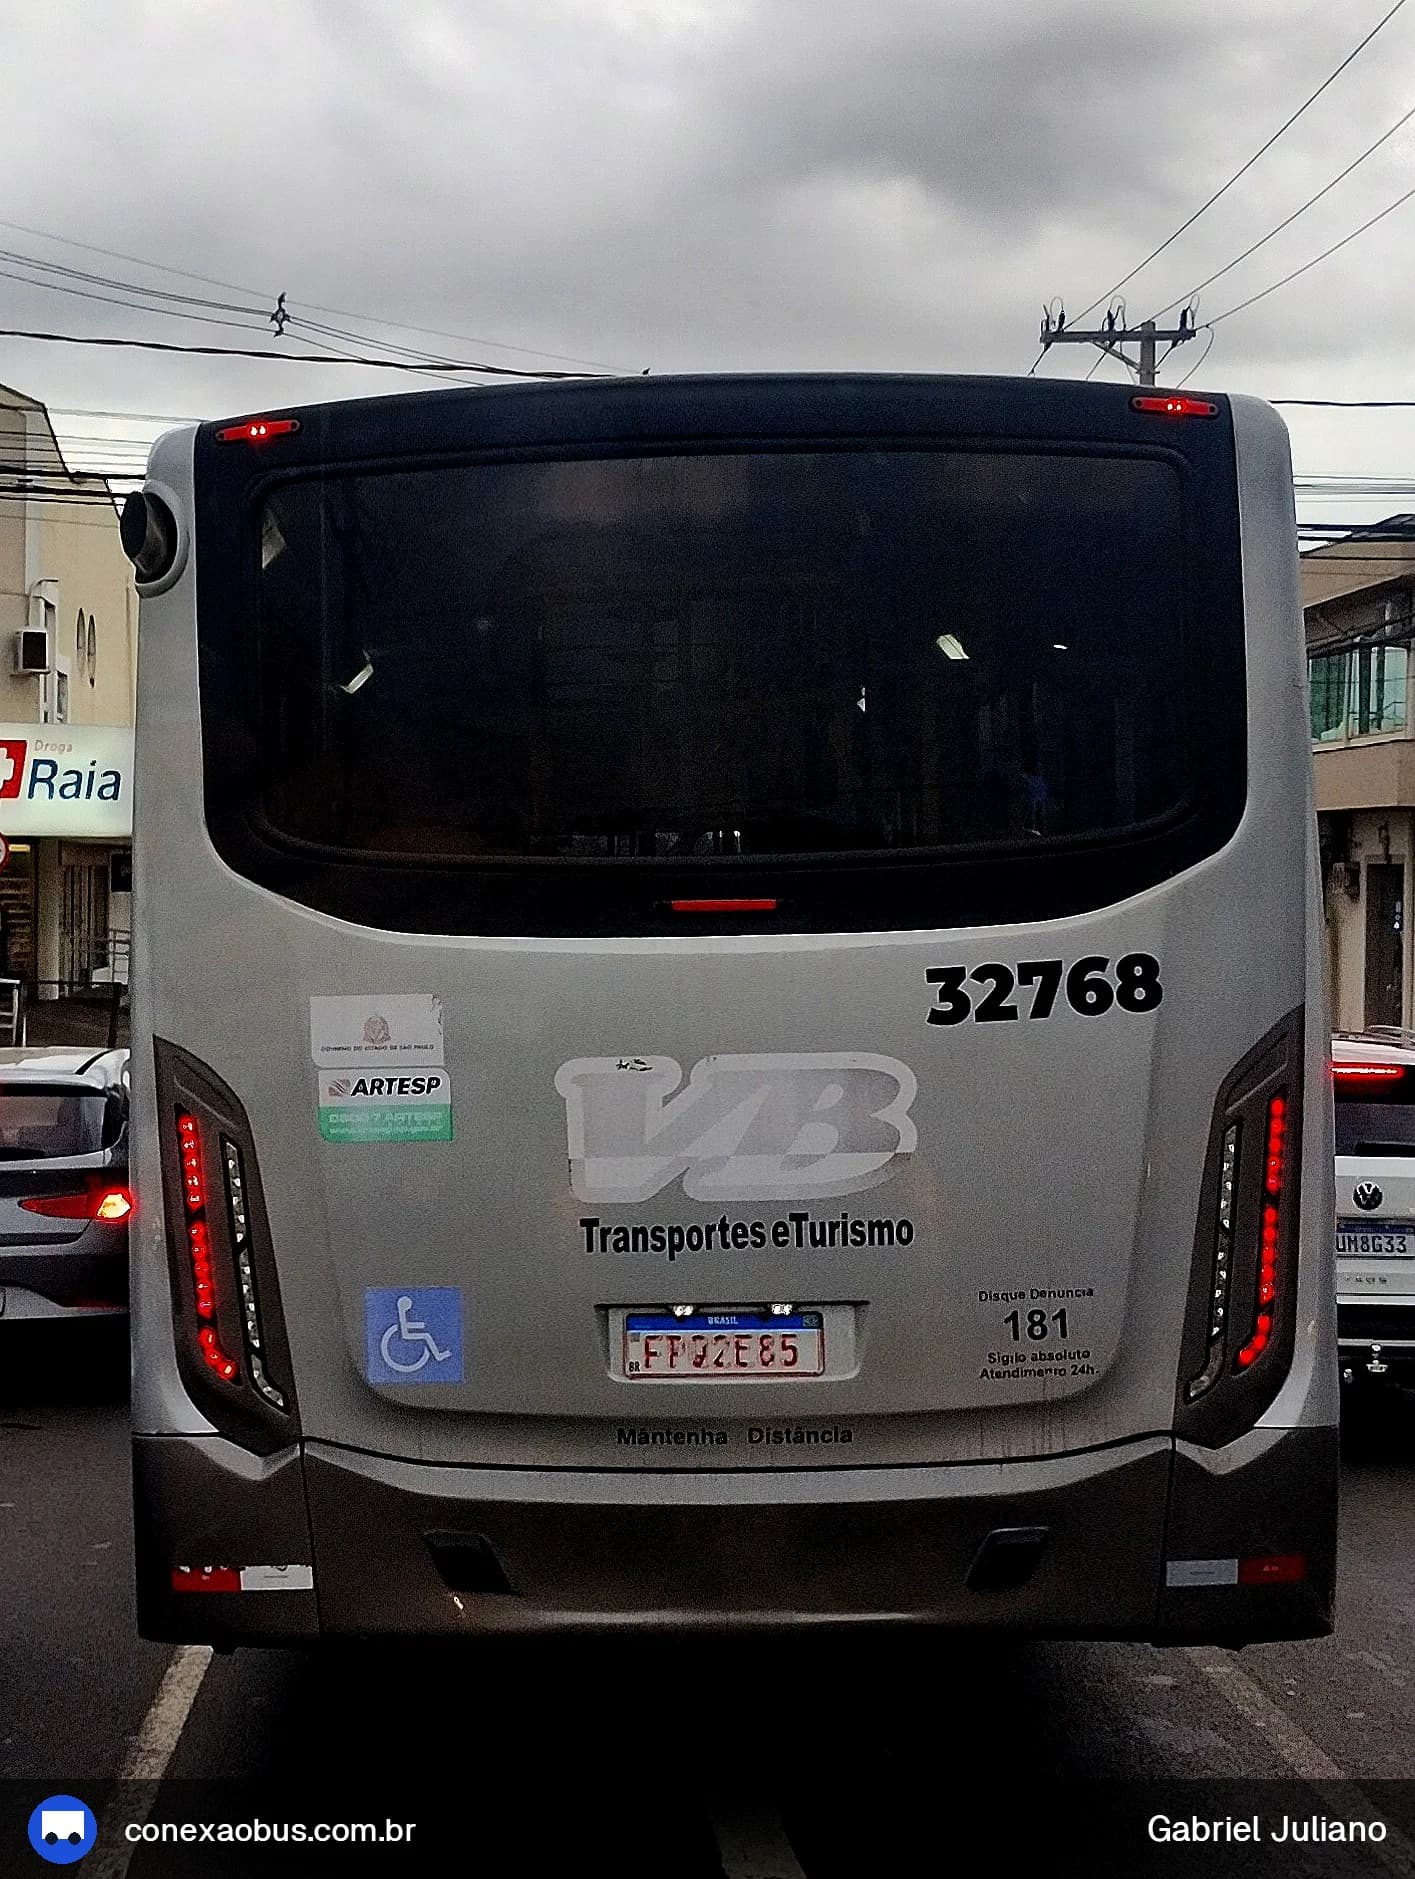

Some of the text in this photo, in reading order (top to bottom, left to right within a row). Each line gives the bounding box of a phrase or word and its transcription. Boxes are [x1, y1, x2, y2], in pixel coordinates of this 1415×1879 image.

[28, 758, 122, 801] Raia
[925, 952, 1163, 1026] 32768
[351, 1076, 442, 1097] ARTESP
[579, 1216, 767, 1261] Transportes
[978, 1290, 1026, 1302] Disque
[1003, 1307, 1068, 1341] 181
[1031, 1350, 1090, 1361] absoluto
